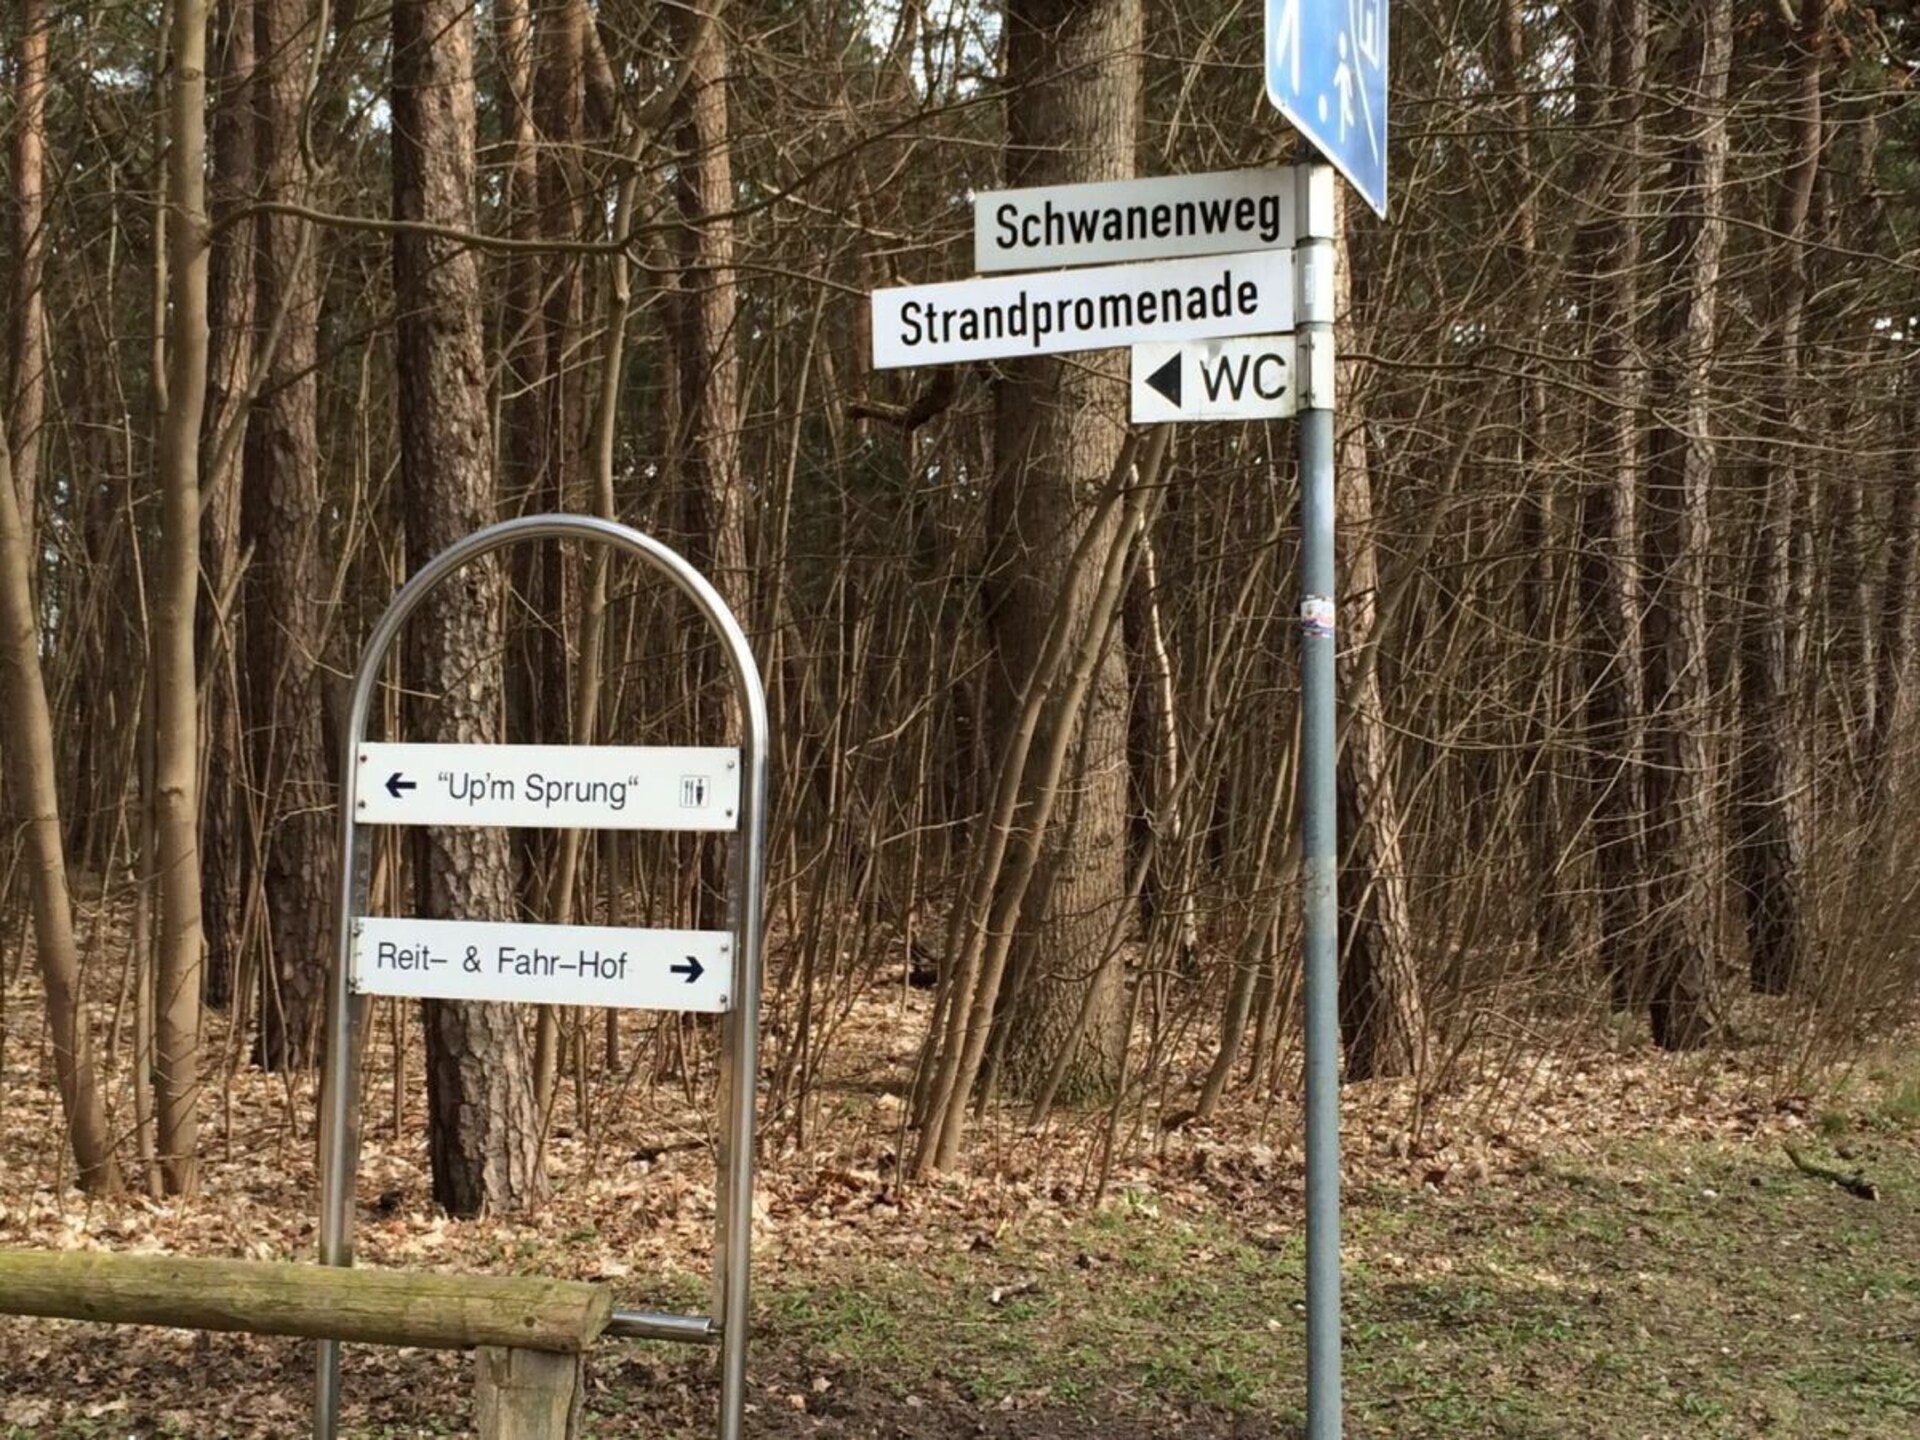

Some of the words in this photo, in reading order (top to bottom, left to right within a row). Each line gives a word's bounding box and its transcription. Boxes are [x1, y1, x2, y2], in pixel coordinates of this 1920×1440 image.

[995, 193, 1281, 250] Schwanenweg
[900, 271, 1258, 347] Strandpromenade
[1200, 353, 1288, 402] WC
[462, 945, 482, 974] &
